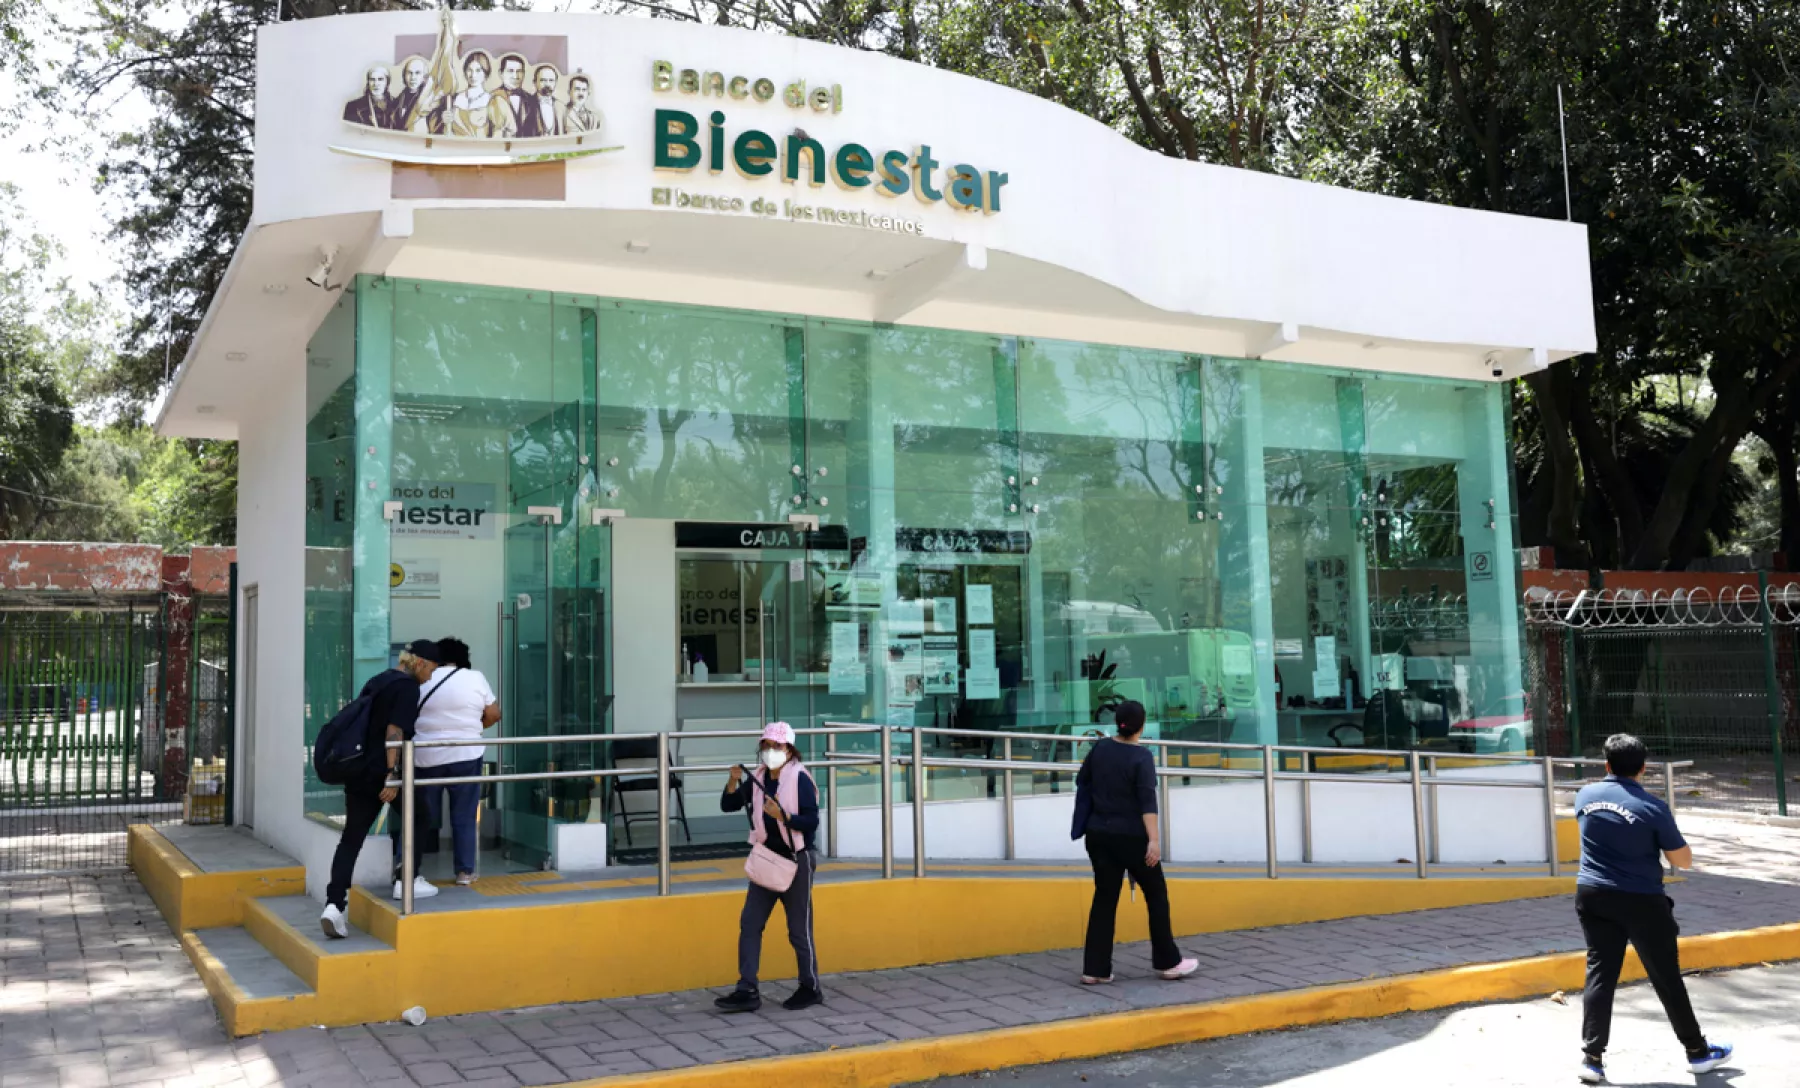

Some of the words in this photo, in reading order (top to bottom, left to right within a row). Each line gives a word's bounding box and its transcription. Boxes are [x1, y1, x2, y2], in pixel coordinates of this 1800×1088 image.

[652, 60, 775, 102] Banco
[783, 78, 843, 114] del
[653, 108, 1009, 217] Bienestar
[651, 187, 671, 205] El
[675, 188, 744, 211] banco
[750, 197, 777, 215] de
[784, 199, 814, 221] los
[817, 206, 925, 236] mexicanos
[392, 486, 423, 499] nco
[428, 486, 455, 499] del
[740, 529, 790, 546] CAJA
[796, 532, 804, 546] 1
[922, 535, 967, 550] CAJA
[718, 587, 739, 600] de
[681, 603, 760, 625] ienes
